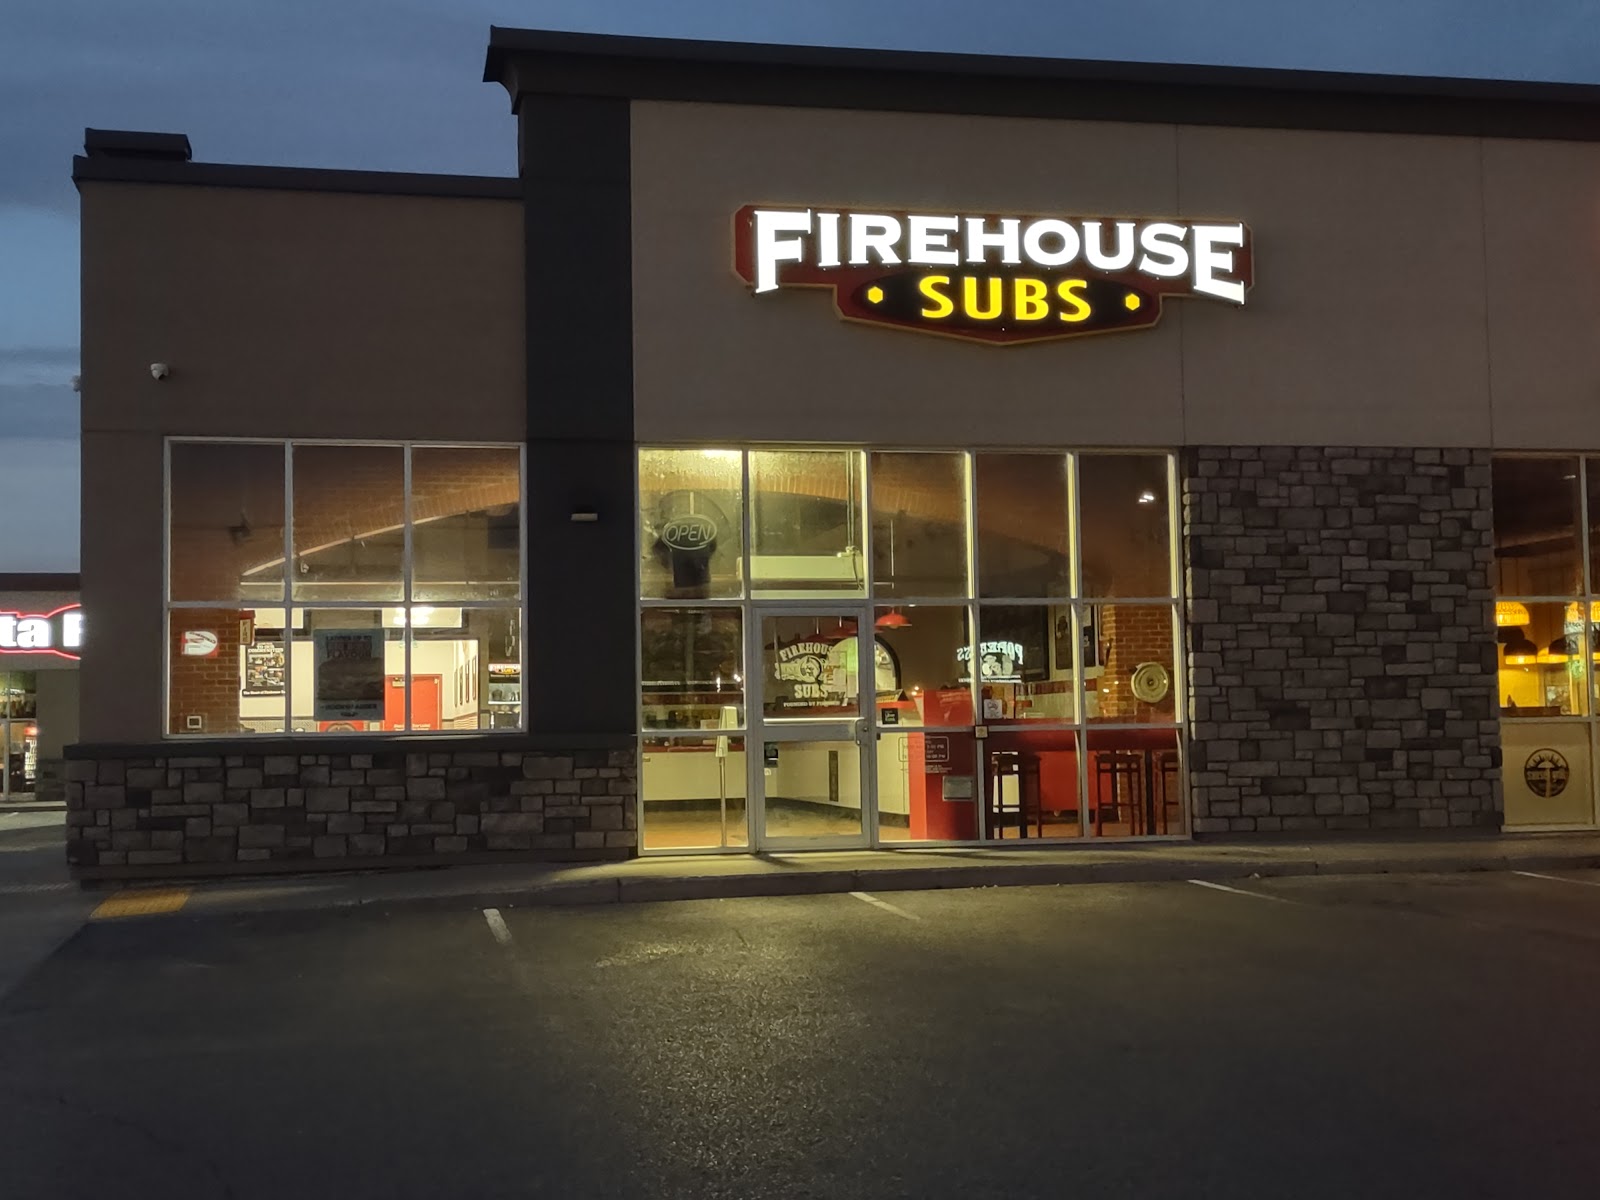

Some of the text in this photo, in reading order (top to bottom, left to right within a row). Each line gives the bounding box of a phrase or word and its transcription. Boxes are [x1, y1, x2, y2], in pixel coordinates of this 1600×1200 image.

[753, 208, 1246, 305] FIREHOUSE
[918, 275, 1092, 322] SUBS
[666, 524, 711, 541] OPEN
[779, 642, 835, 661] FIREHOUS
[794, 684, 828, 698] SUBS
